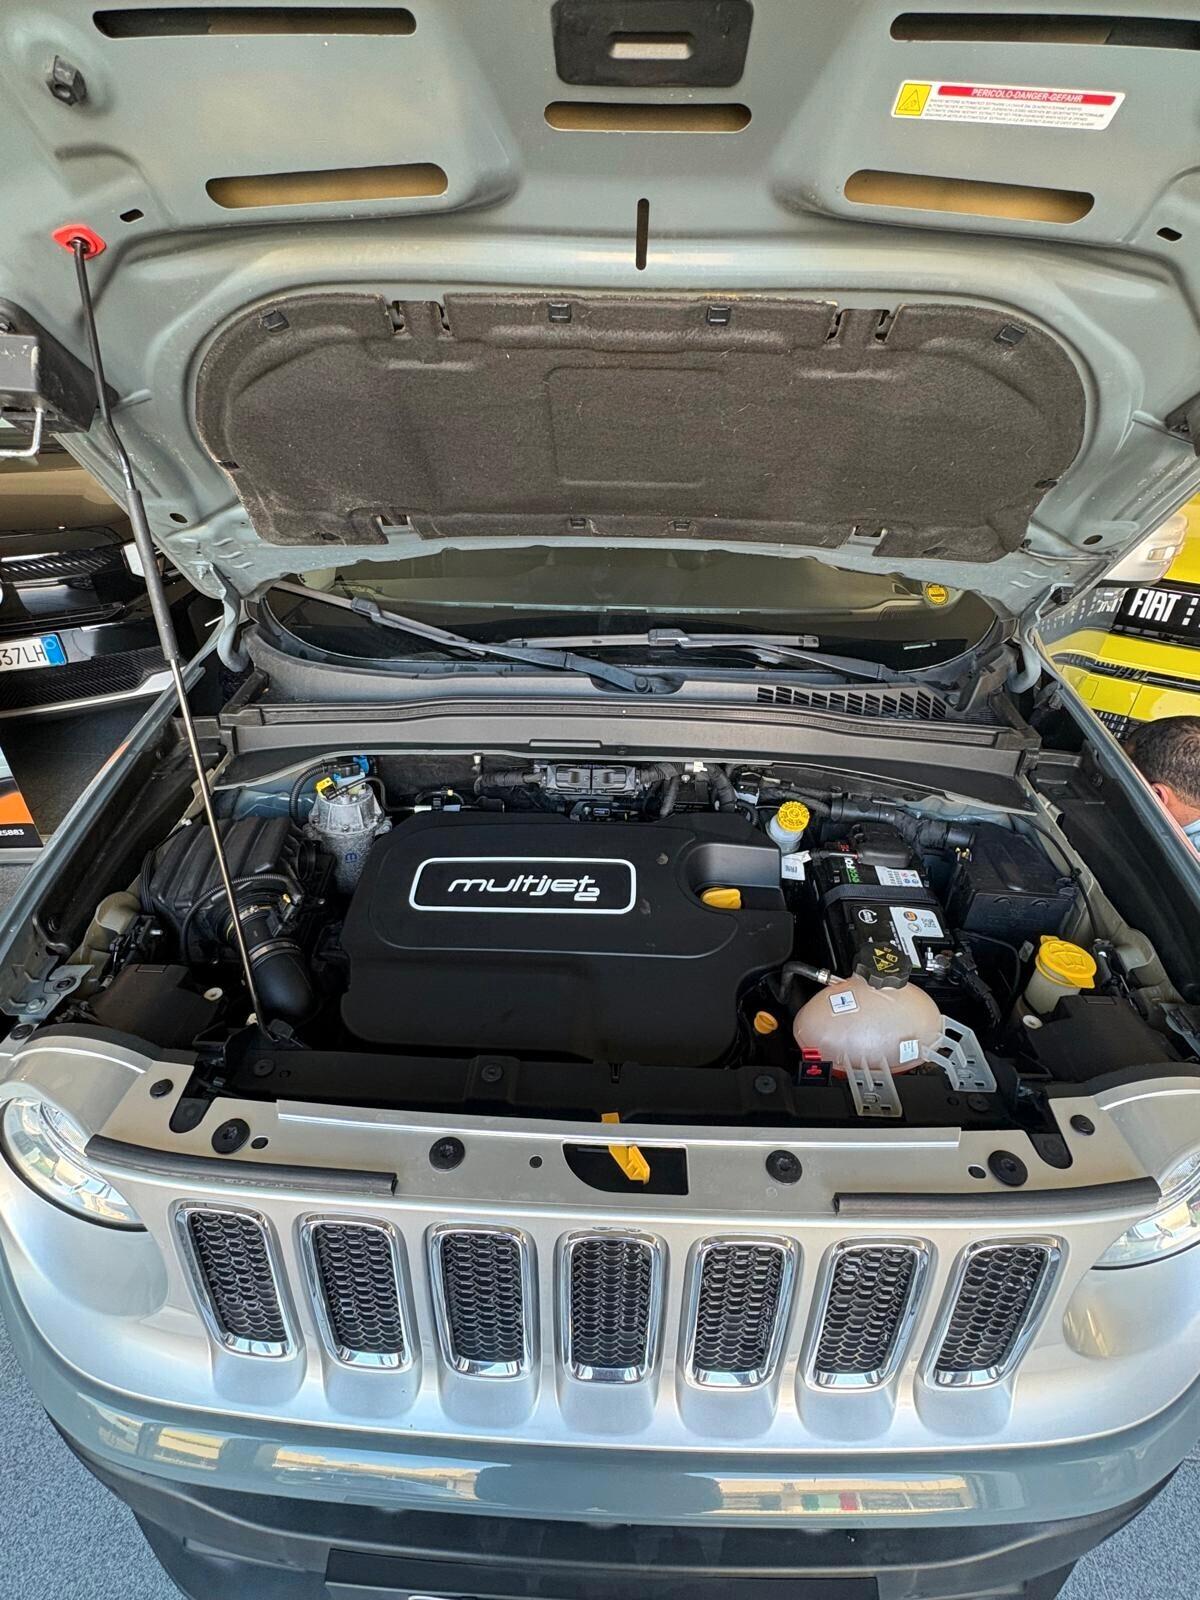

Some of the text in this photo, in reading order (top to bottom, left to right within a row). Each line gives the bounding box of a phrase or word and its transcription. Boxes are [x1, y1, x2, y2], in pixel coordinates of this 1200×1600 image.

[970, 88, 1084, 103] PERICOLO-DANGER-GEFAHR
[1128, 588, 1182, 622] FIAT
[0, 645, 47, 666] 37LH
